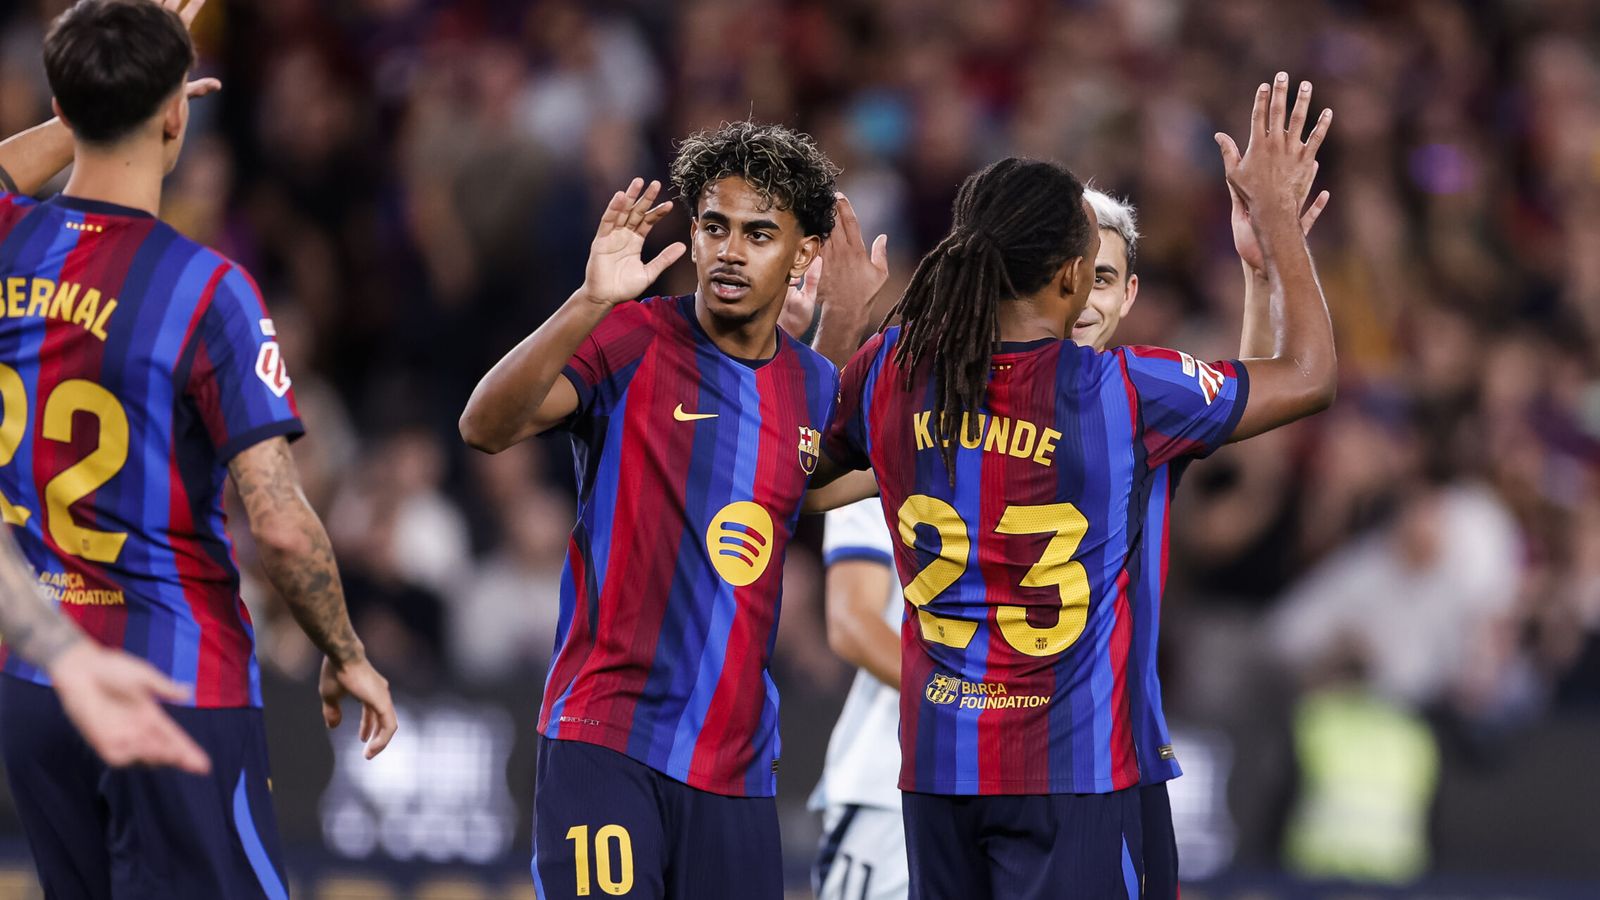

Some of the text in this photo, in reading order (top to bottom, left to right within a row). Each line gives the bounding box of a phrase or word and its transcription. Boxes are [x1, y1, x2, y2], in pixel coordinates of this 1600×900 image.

[897, 494, 1091, 657] 23
[34, 584, 125, 605] OUNDATION
[961, 681, 1007, 697] BARÇA
[959, 695, 1050, 709] FOUNDATION
[565, 824, 634, 896] 10
